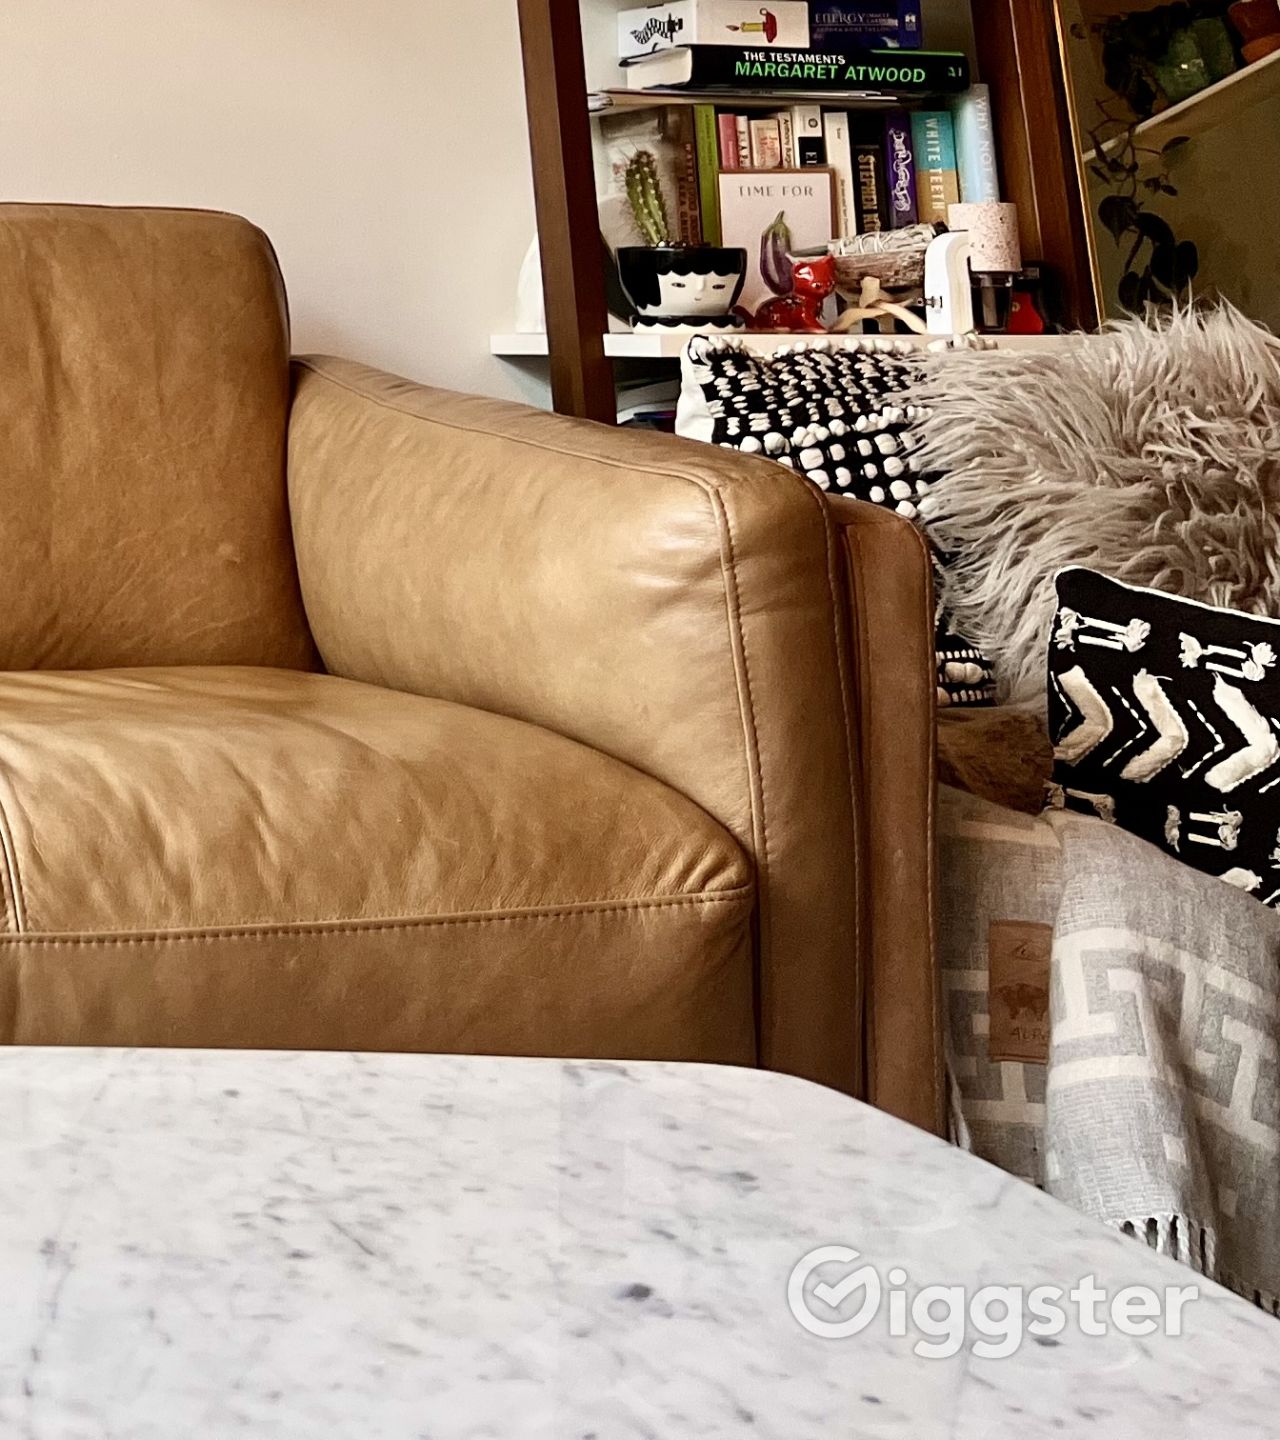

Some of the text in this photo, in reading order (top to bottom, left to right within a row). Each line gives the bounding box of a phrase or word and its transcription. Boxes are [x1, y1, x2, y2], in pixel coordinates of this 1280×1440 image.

[735, 61, 926, 82] MARGARET ATWOOD
[743, 51, 845, 64] THE TESTAMENTS
[976, 96, 989, 134] WHY
[925, 118, 945, 210] WHITE TEETH
[981, 140, 993, 173] NOT
[739, 184, 814, 198] TIME FOR
[857, 154, 878, 210] STEPHEN
